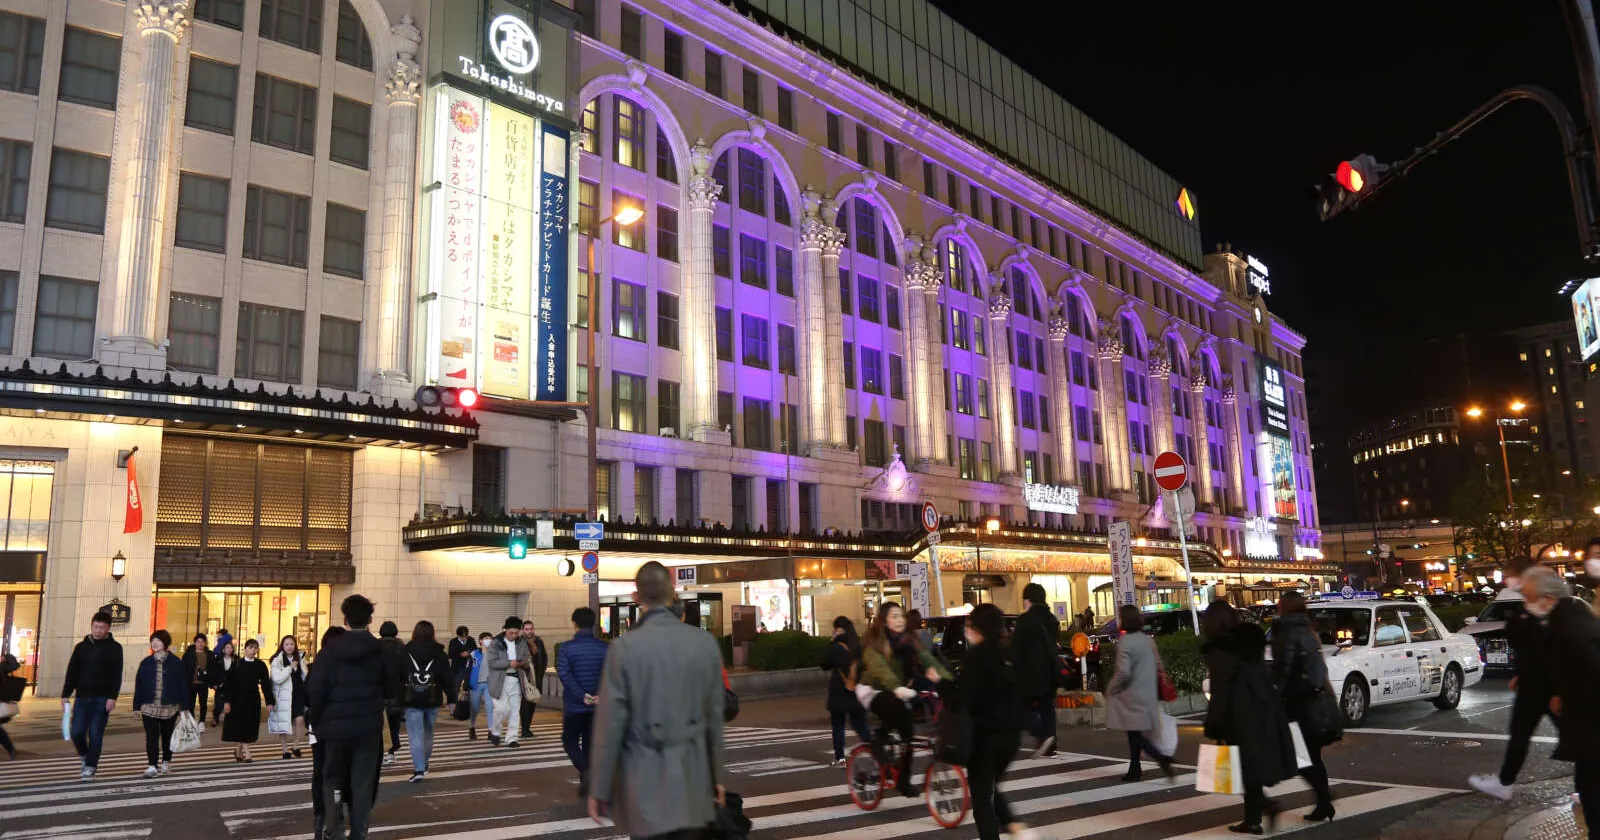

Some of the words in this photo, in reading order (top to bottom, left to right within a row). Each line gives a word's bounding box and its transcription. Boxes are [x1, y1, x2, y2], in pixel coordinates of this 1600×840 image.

[459, 56, 564, 112] Takashimaya
[554, 181, 564, 235] タカシマヤ
